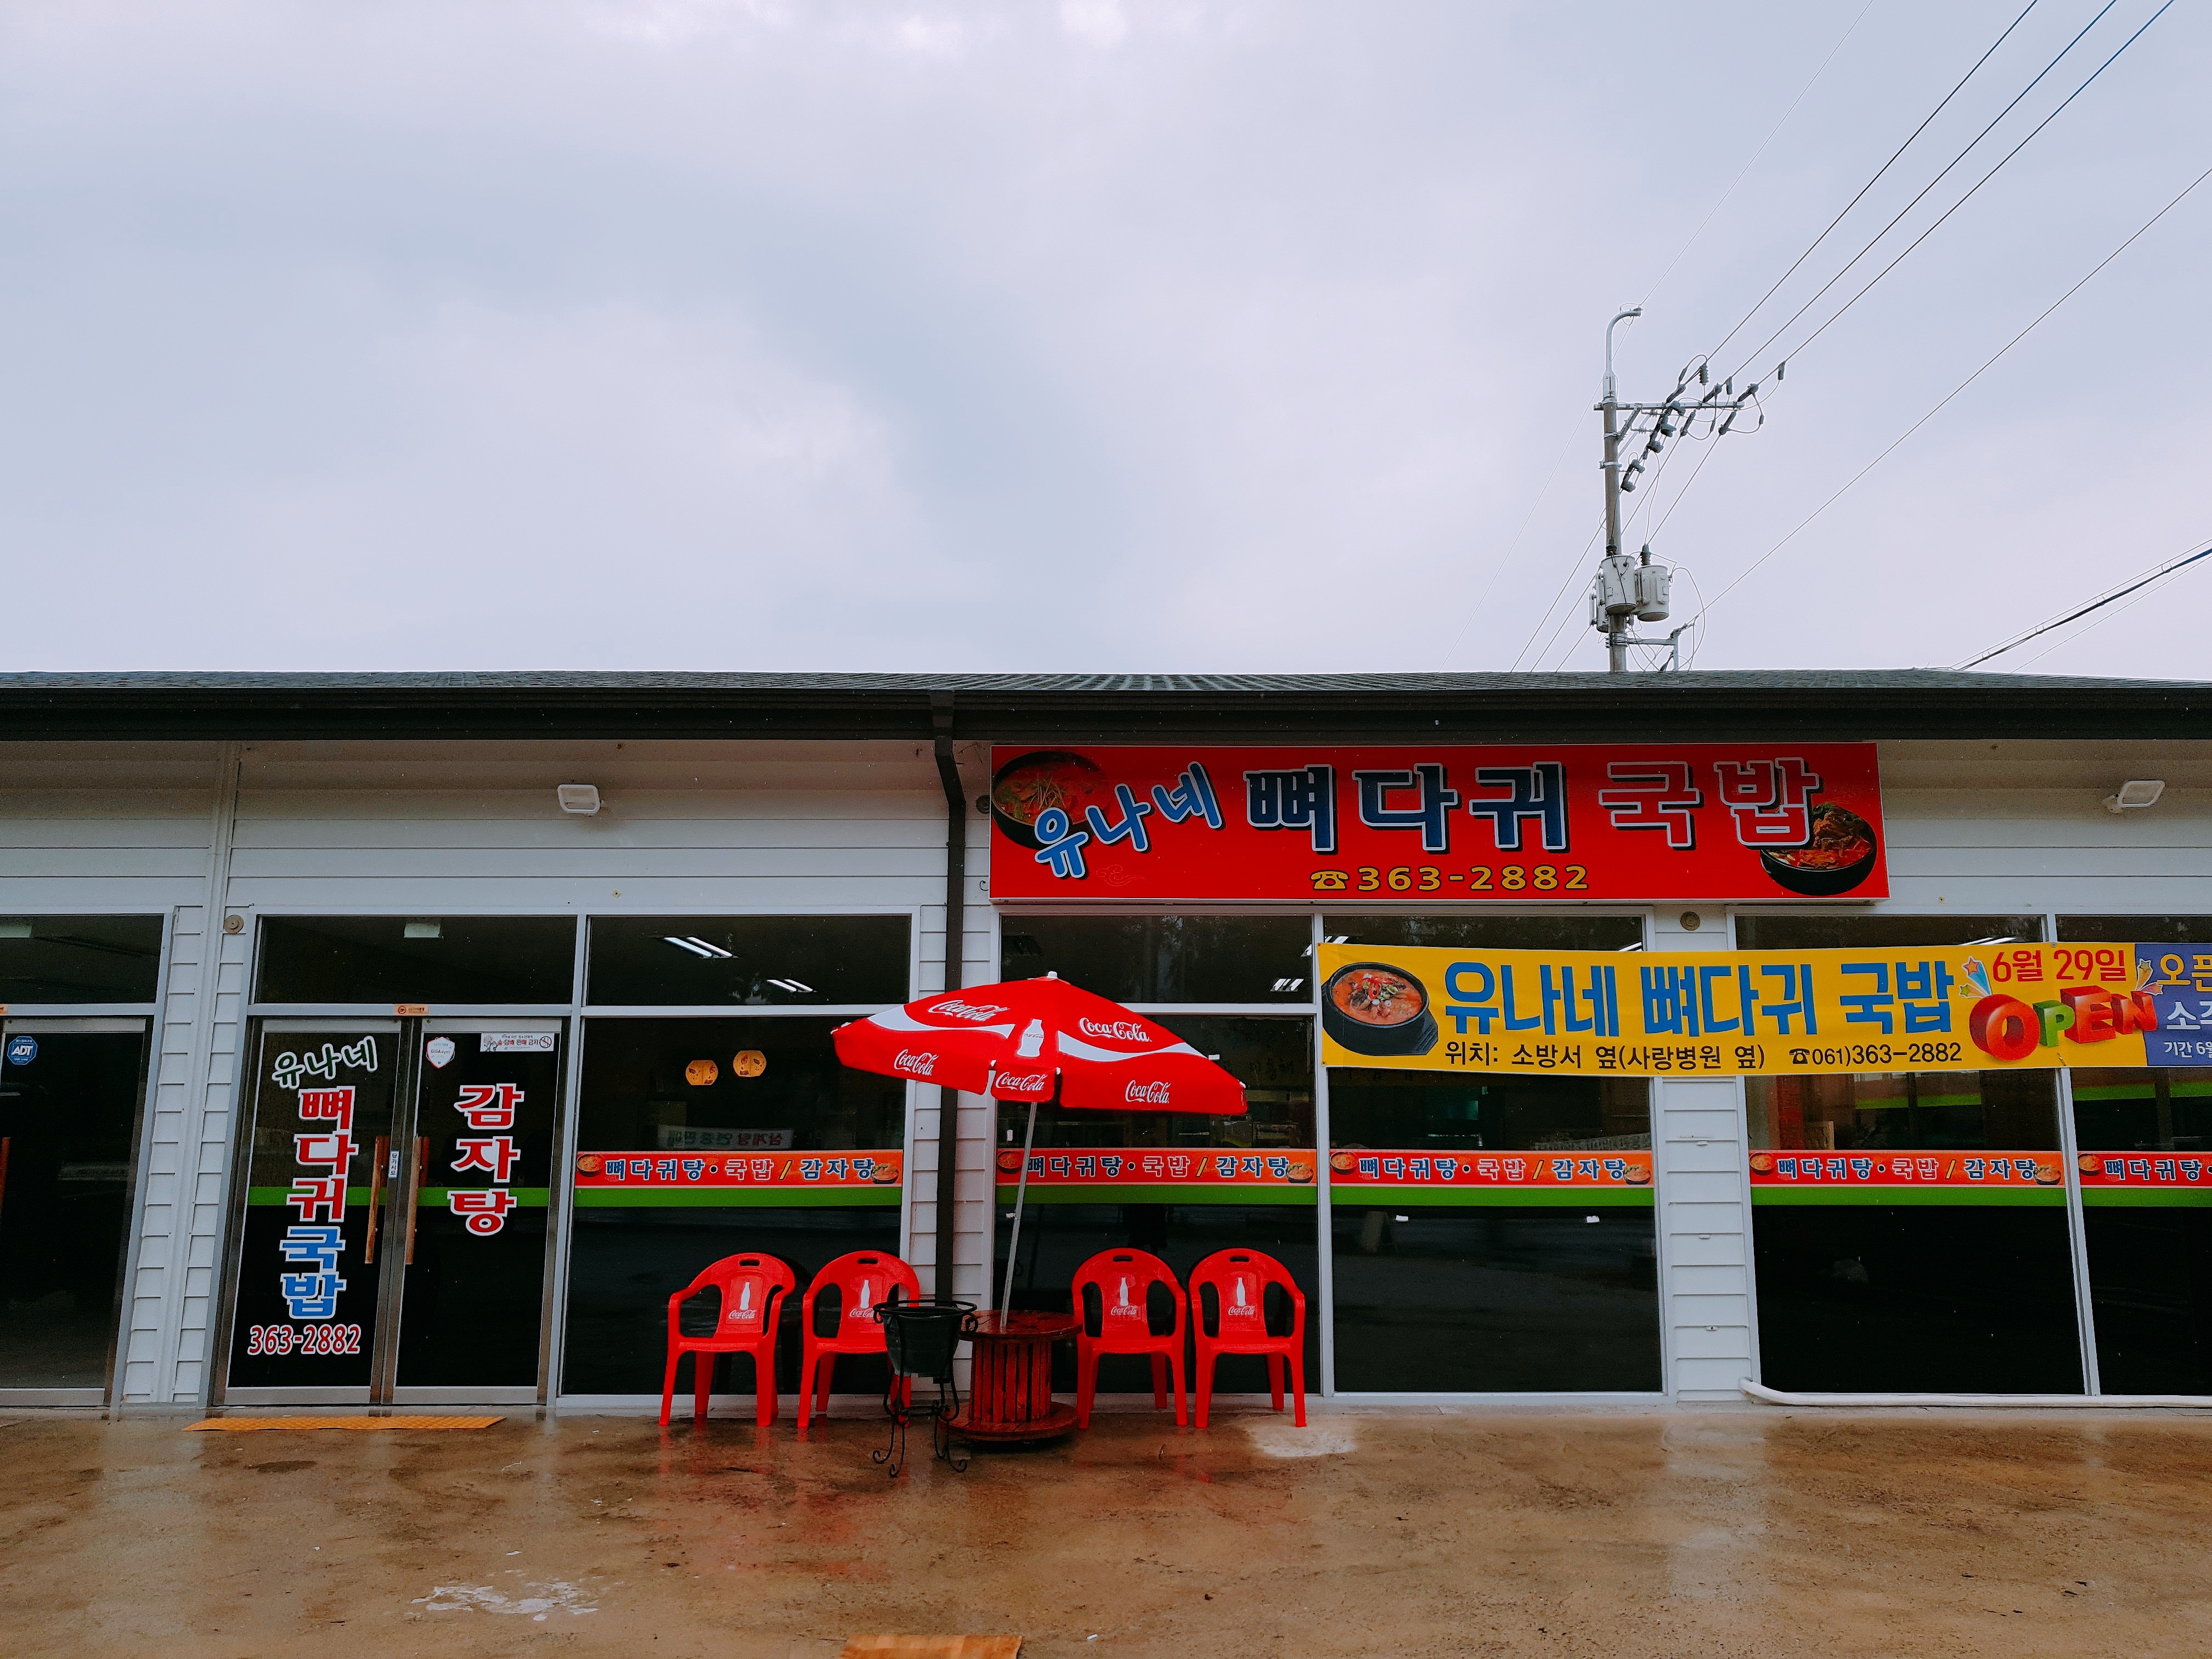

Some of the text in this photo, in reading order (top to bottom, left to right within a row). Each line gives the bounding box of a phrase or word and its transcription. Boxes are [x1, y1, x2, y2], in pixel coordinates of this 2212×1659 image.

[1034, 757, 1820, 879] 유나네 뼈다귀 국밥
[1357, 865, 1589, 891] 363-2882
[1993, 949, 2127, 983] 6월 29일
[928, 1000, 1010, 1022] Coca-Cola
[1444, 960, 1954, 1037] 유나네 뼈다귀 국밥
[1079, 1017, 1153, 1042] Coca-Cola
[1970, 985, 2158, 1062] OPEN
[11, 1045, 34, 1056] ADT
[272, 1036, 378, 1089] 유나네
[894, 1049, 939, 1076] Coca-Cola
[1445, 1041, 1499, 1066] 위치:
[1511, 1044, 1582, 1069] 소방서
[1734, 1044, 1765, 1070] 옆)
[2163, 1041, 2193, 1058] 기간
[995, 1071, 1048, 1092] Coca-Cola
[1125, 1080, 1171, 1104] Coca-Cola
[447, 1083, 524, 1237] 감자탕
[728, 1309, 757, 1320] Coca-Cola
[1110, 1305, 1138, 1316] Coca-Cola
[1228, 1305, 1255, 1316] Coca-Cola
[247, 1324, 361, 1356] 363-2882
